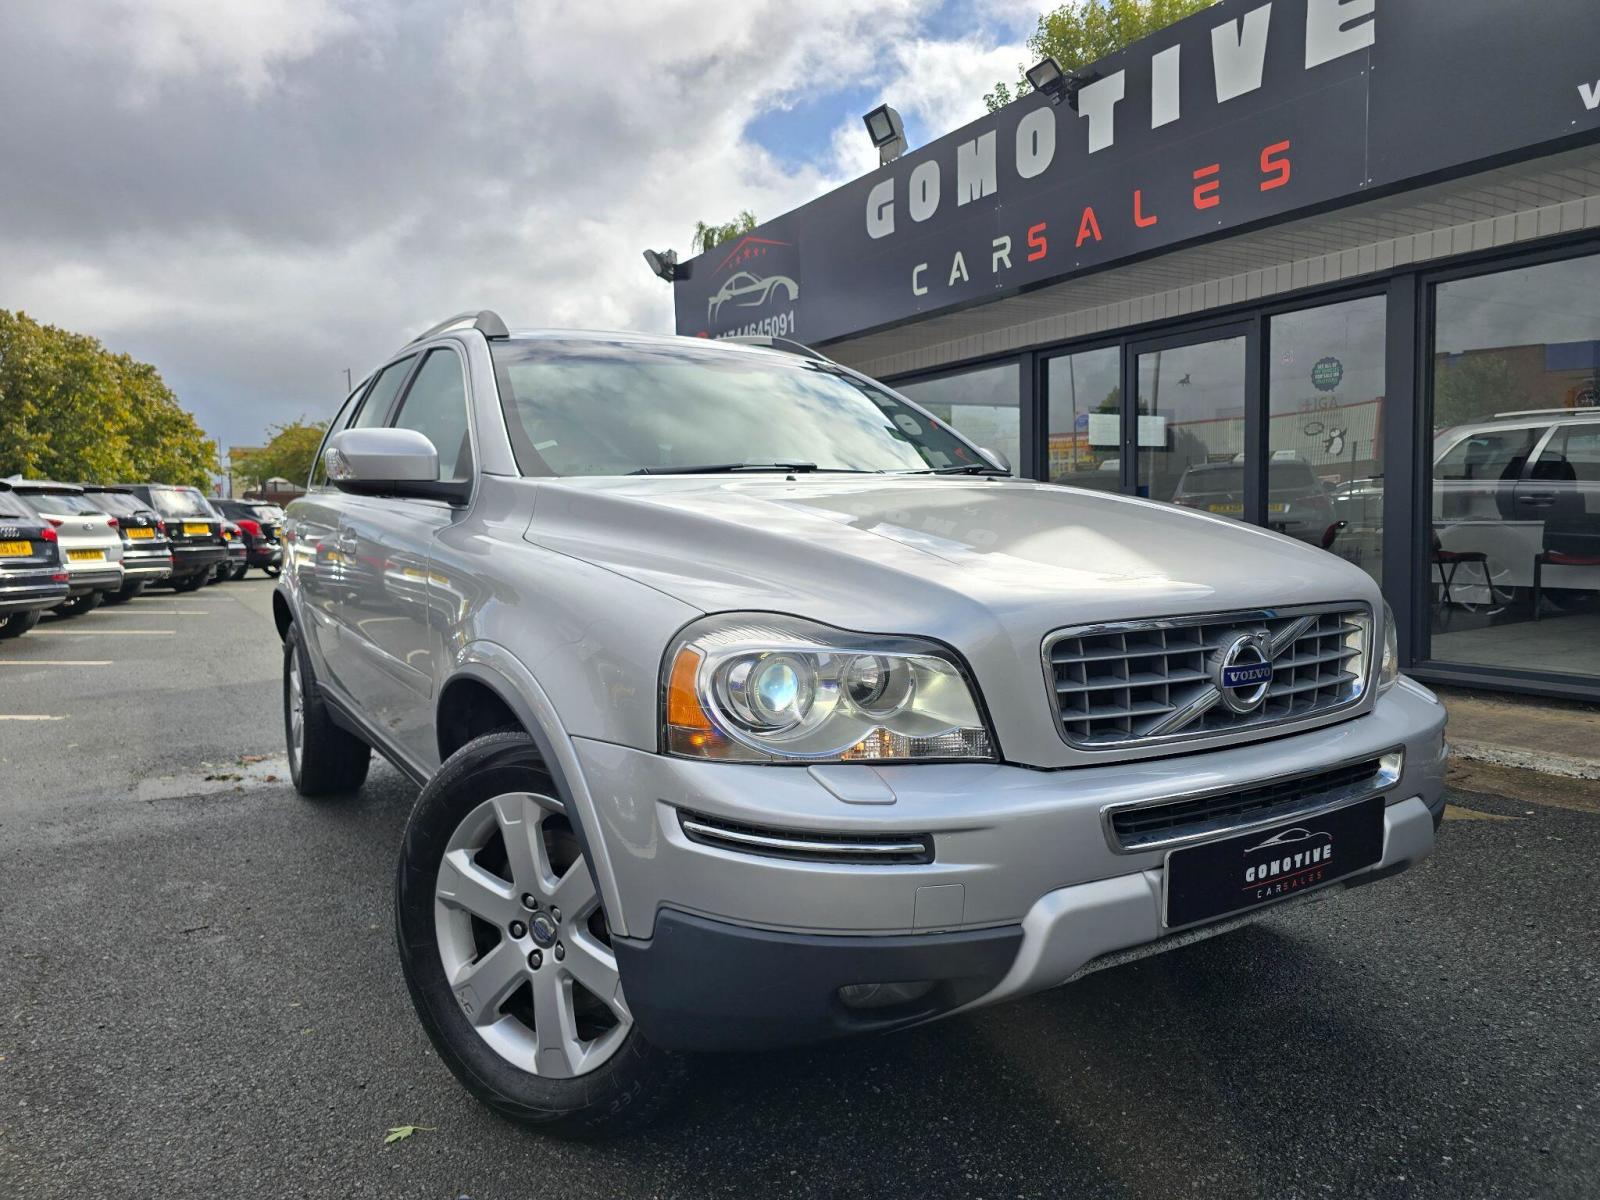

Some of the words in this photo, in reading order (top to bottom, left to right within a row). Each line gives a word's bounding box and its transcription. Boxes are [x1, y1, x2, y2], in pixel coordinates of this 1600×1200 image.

[866, 0, 1375, 239] GOMOTIVE
[1229, 667, 1271, 682] VOLVO
[1245, 844, 1332, 883] GOMOTIVE
